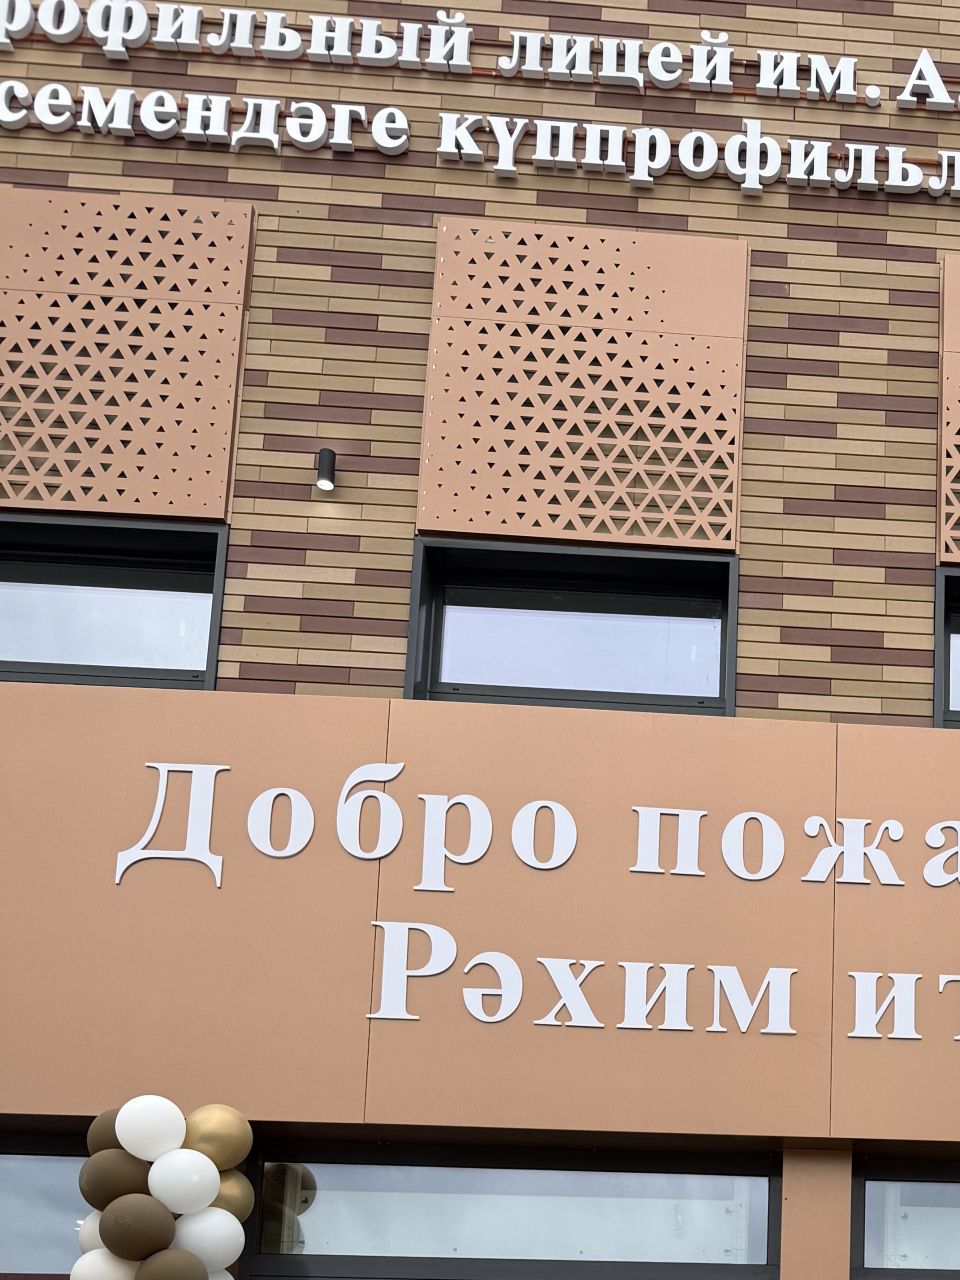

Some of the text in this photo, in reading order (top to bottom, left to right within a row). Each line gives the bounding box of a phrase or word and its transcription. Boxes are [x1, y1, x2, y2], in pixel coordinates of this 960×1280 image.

[499, 30, 734, 94] лицей
[115, 762, 579, 893] Добро
[365, 920, 798, 1036] Рәхим
